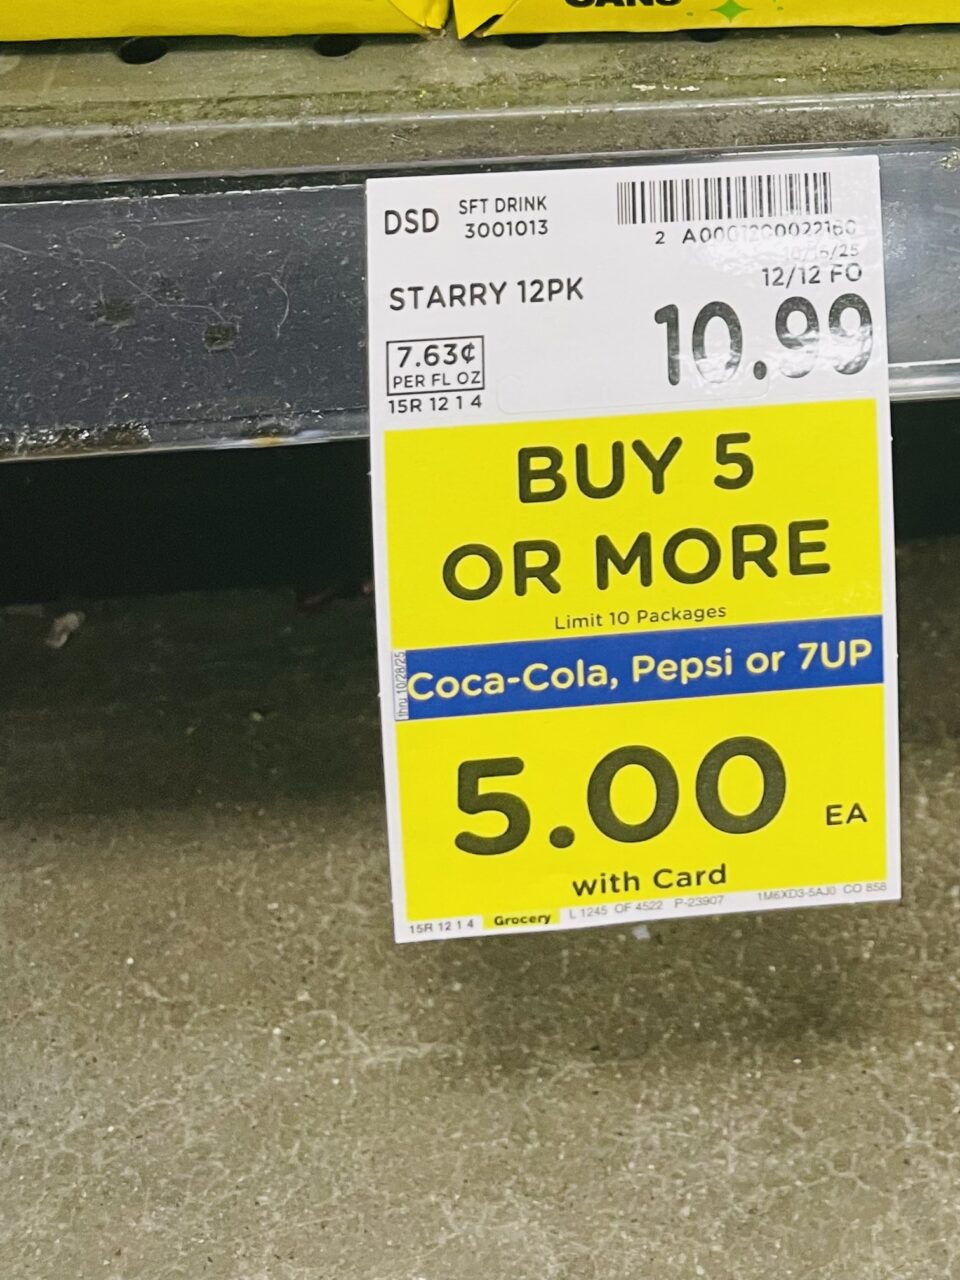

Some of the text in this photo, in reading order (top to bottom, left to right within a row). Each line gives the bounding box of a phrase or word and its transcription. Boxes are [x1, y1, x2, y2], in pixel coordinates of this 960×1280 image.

[458, 195, 547, 215] SFT DRINK
[384, 208, 440, 236] DSD
[464, 219, 549, 240] 3001013
[655, 231, 665, 245] 2
[762, 265, 821, 288] 12/12
[388, 276, 584, 312] STARRY 12PK
[654, 292, 874, 387] 10.99
[397, 342, 476, 368] 7.63¢
[393, 370, 481, 389] PER FL OZ
[388, 394, 482, 414] 15R 12 1 4
[517, 431, 754, 504] BUY 5
[442, 519, 831, 601] OR MORE
[555, 605, 727, 630] Limit 10 Packages
[407, 638, 872, 702] Coca-Cola, Pepsi or 7UP
[455, 736, 868, 855] 5.00 EA
[573, 863, 727, 897] with Card
[843, 884, 862, 895] CO
[494, 914, 551, 926] Grocery
[569, 900, 663, 919] L 1245 OF 4522
[410, 923, 432, 934] 15R
[438, 921, 451, 931] 12
[467, 919, 474, 928] 4
